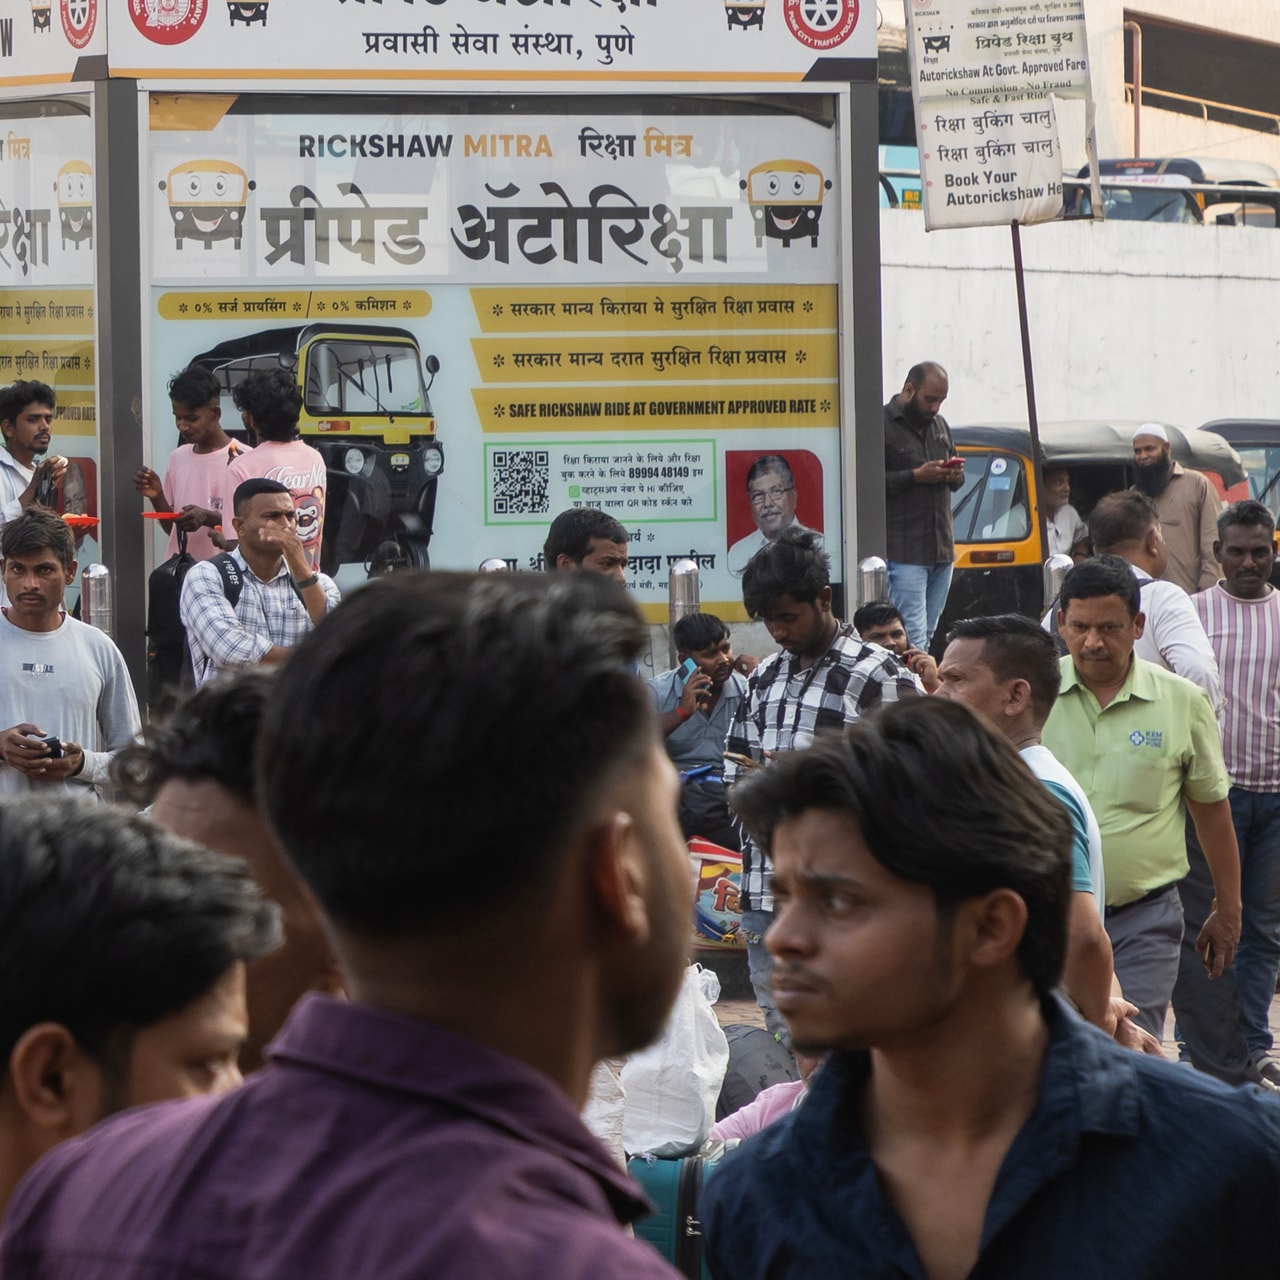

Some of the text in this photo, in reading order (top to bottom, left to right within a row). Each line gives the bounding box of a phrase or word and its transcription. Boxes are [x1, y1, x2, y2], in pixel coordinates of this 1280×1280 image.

[788, 10, 855, 47] PUNE CITY TRAFFIC POLICE
[1016, 32, 1046, 47] रिक्षा
[362, 25, 440, 55] प्रवासी
[450, 23, 500, 55] सेवा
[595, 24, 635, 66] पुणे
[919, 58, 1087, 82] Autorickshaw At Govt. Approved Fare
[945, 79, 1072, 98] No Commission No Fraud
[969, 96, 990, 106] Safe
[992, 95, 1001, 104] &
[1004, 93, 1024, 103] Fast
[934, 115, 966, 133] रिक्षा
[971, 109, 1014, 135] बुकिंग
[7, 129, 31, 161] मित्र
[299, 133, 553, 159] RICKSHAW MITRA
[578, 126, 693, 162] रिक्षा मित्र
[937, 139, 1053, 165] रिक्षा बुकिंग चालु
[945, 170, 1018, 188] Book Your
[946, 186, 1044, 207] Autorickshaw
[260, 182, 428, 267] प्रीपेड
[217, 299, 238, 313] सर्ज
[242, 297, 287, 313] प्रायसिंग
[355, 296, 397, 312] कमिशन
[510, 295, 795, 320] सरकार मान्य किराया मे सुरक्षित रिक्षा प्रवास
[15, 350, 40, 376] सुरक्षित
[513, 345, 786, 372] सरकार मान्य दरात सुरक्षित रिक्षा प्रवास
[509, 399, 817, 418] SAFE RICKSHAW RIDE AT GOVERNMENT APPROVED RATE
[563, 452, 701, 465] रिक्षा किराया जानने के लिये और रिक्षा
[579, 467, 704, 479] करने के लिये 89994 48149 इस
[620, 482, 636, 494] नंबर
[639, 481, 645, 493] पे
[647, 483, 655, 493] Hi
[658, 482, 685, 495] कीजिए
[605, 497, 657, 508] वाला QR कोड
